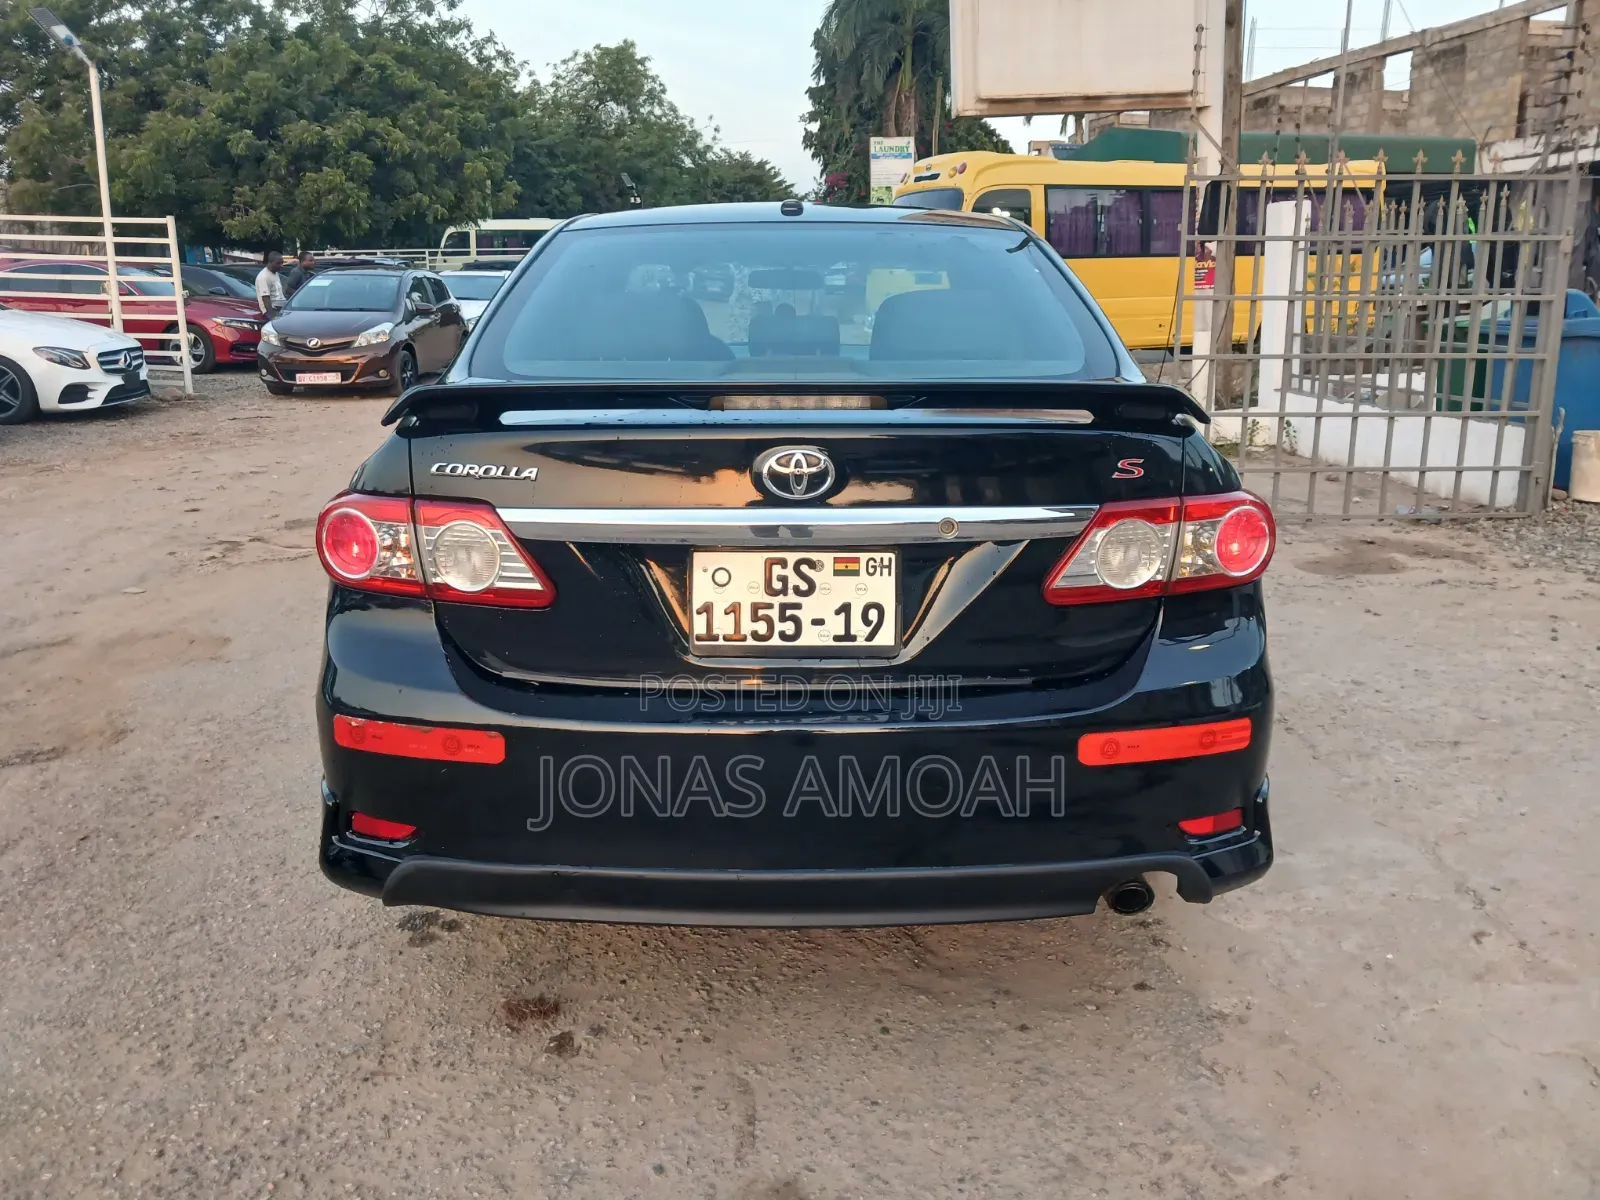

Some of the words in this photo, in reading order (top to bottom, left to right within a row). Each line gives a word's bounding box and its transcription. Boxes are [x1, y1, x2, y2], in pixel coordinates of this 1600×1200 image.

[874, 145, 910, 153] LAUNDRY
[430, 462, 539, 481] COROLLA
[1111, 458, 1145, 479] S
[764, 556, 817, 598] GS
[865, 556, 892, 577] GH
[695, 601, 886, 642] 1155-19
